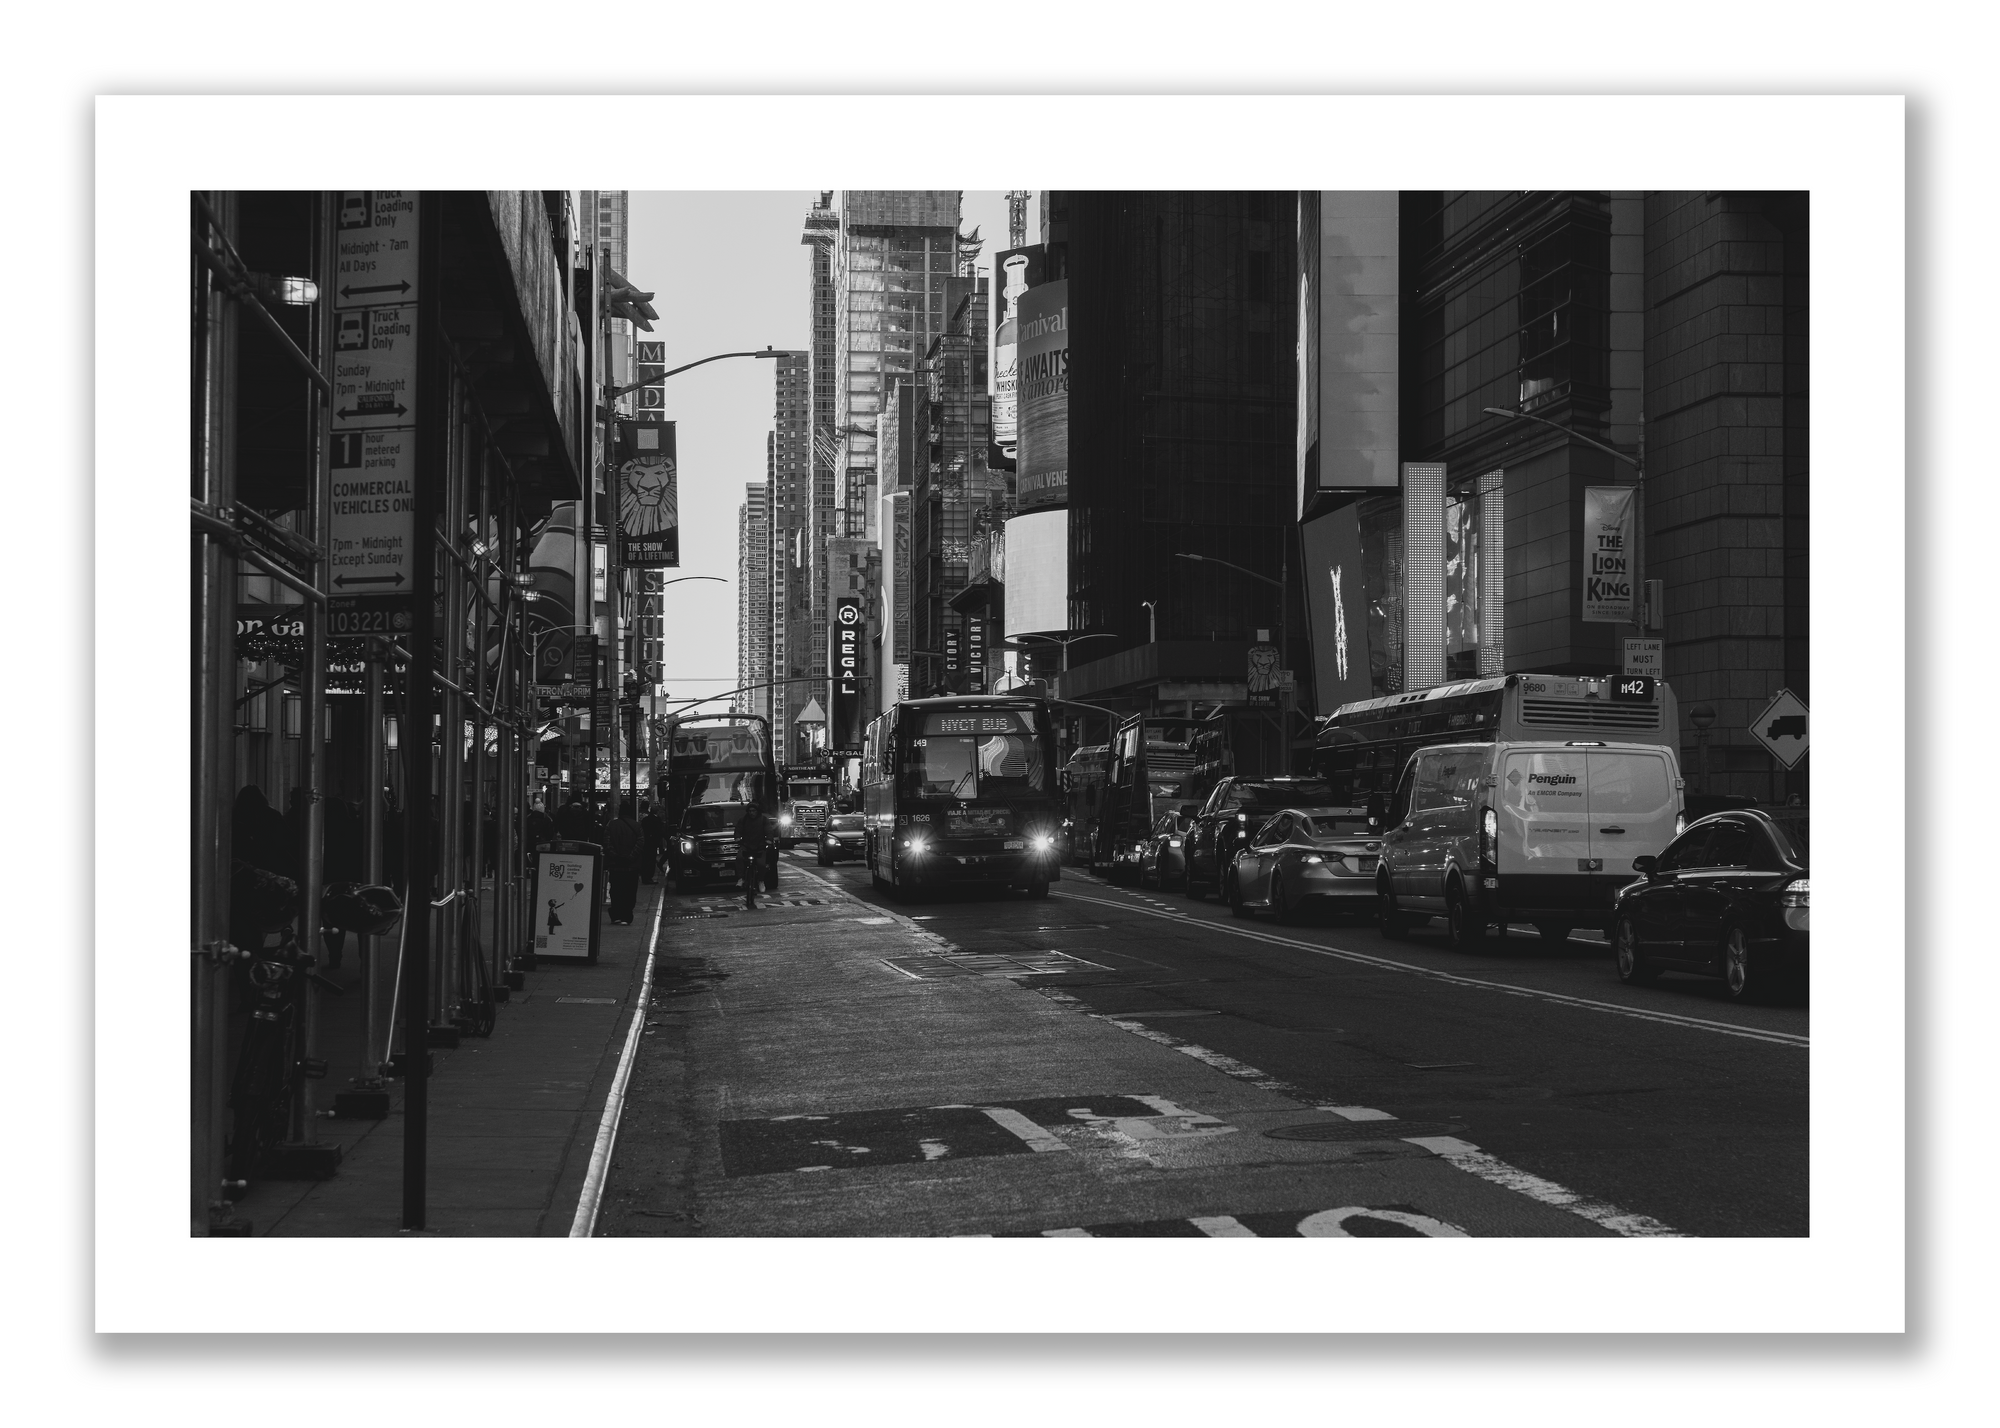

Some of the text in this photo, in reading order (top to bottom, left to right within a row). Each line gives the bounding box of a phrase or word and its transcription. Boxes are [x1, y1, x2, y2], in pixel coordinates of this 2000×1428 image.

[376, 191, 402, 200] Truck
[375, 199, 413, 213] Loading
[374, 214, 397, 228] Only
[340, 241, 379, 256] Midnight
[389, 239, 409, 251] 7am
[340, 260, 377, 273] All Days
[373, 310, 400, 322] Truck
[372, 322, 411, 336] Loading
[371, 337, 394, 351] Only
[336, 364, 371, 378] Sunday
[1024, 348, 1069, 384] AWAITS
[336, 383, 356, 396] 7pm
[365, 379, 406, 394] Midnight
[996, 380, 1017, 392] WHISK
[365, 434, 385, 443] hour
[341, 434, 350, 464] 1
[365, 444, 400, 455] metered
[365, 457, 396, 470] parking
[1046, 469, 1068, 487] VENE
[333, 480, 411, 497] COMMERCIAL
[333, 498, 415, 515] VEHICLES ONL
[1600, 523, 1620, 533] Disney
[332, 539, 353, 552] 7pm
[362, 536, 403, 550] Midnight
[628, 542, 663, 552] THE SHOW
[1597, 535, 1623, 548] THE
[332, 552, 403, 567] Except Sunday
[628, 551, 675, 561] OF A LIFETIME
[1592, 553, 1626, 575] LION
[1587, 577, 1630, 602] KING
[330, 600, 356, 608] Zone#
[330, 611, 390, 632] 103221
[947, 632, 958, 670] CTORY
[970, 617, 982, 673] VICTORY
[1626, 643, 1660, 651] LEFT LANE
[841, 630, 856, 694] REGAL
[1632, 655, 1654, 664] MUST
[1523, 683, 1546, 692] 9680
[1621, 680, 1644, 695] M42
[941, 718, 1008, 731] NYCT BUS
[913, 739, 927, 747] 149
[1528, 774, 1577, 786] Penguin
[1557, 790, 1582, 798] Company
[912, 814, 930, 822] 1626
